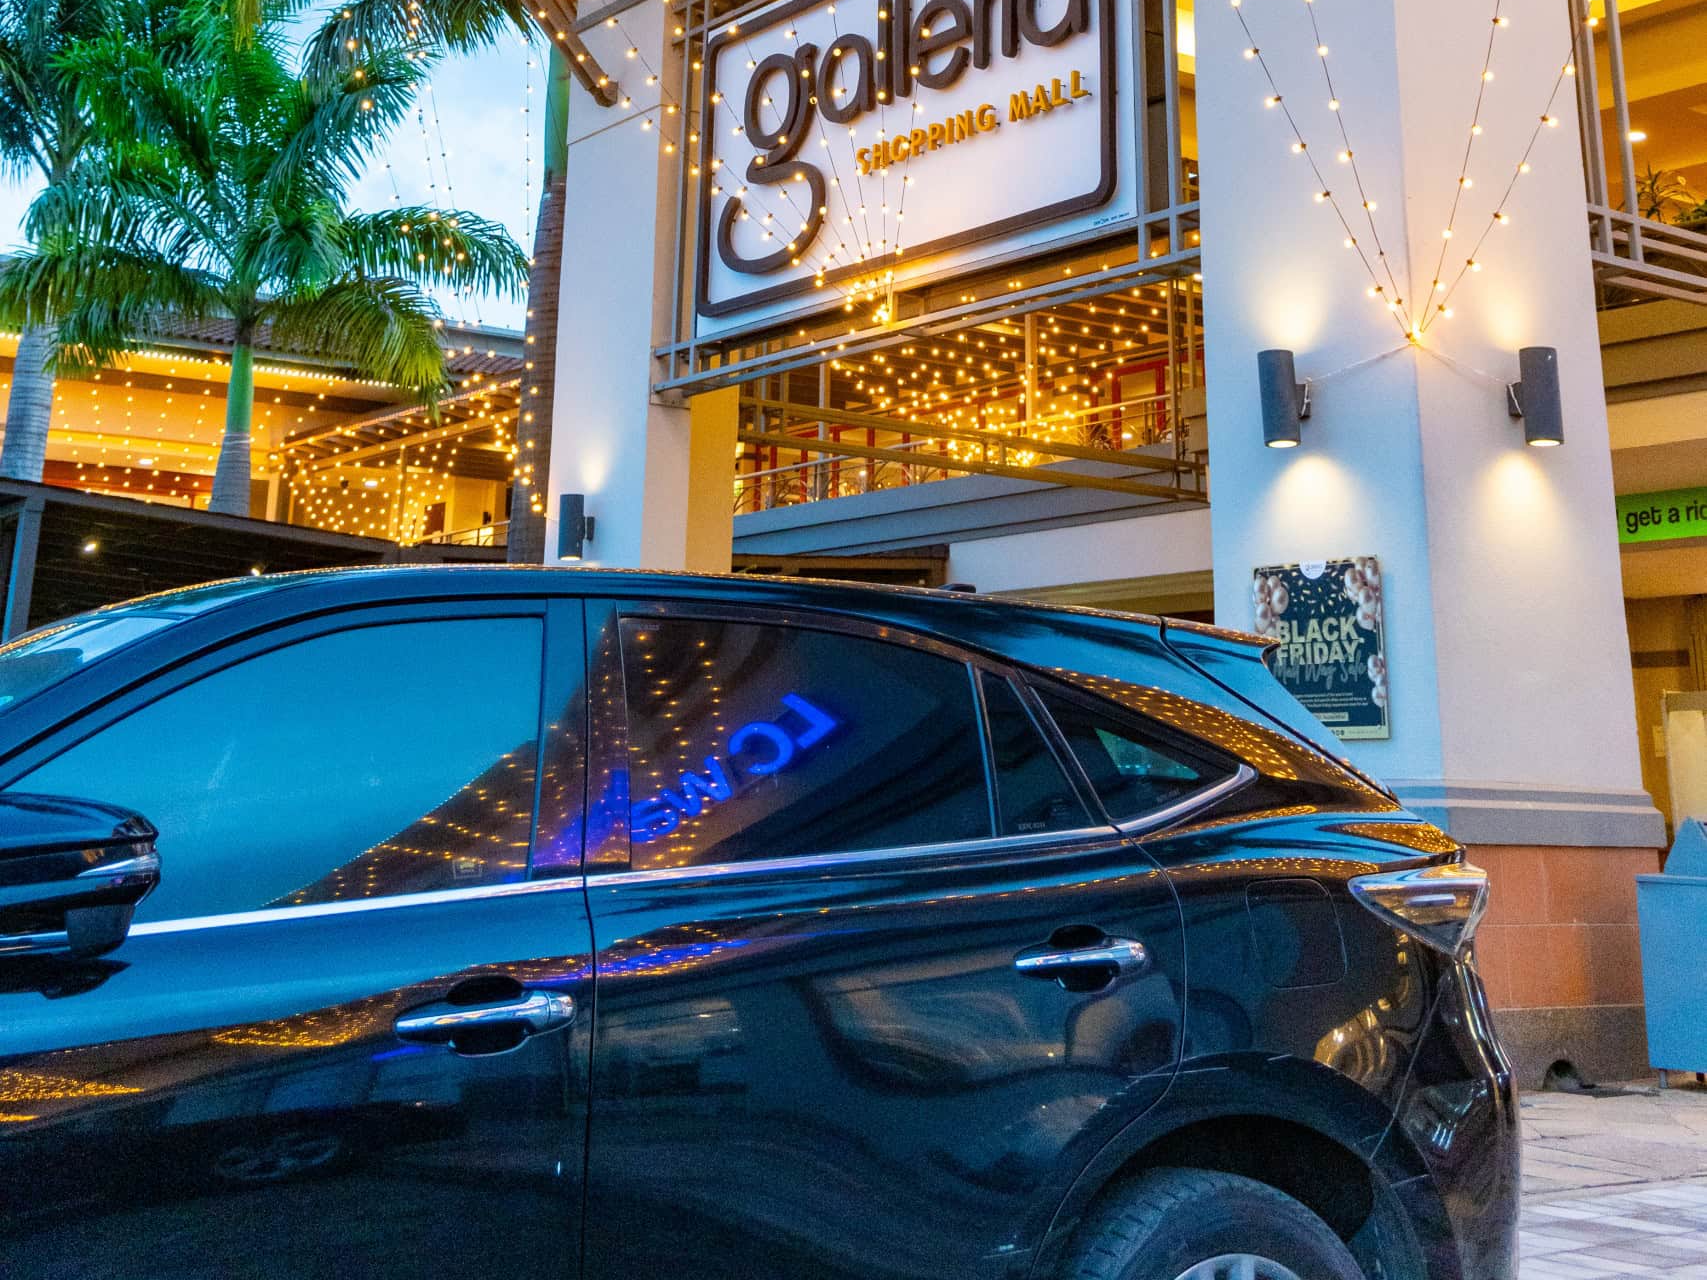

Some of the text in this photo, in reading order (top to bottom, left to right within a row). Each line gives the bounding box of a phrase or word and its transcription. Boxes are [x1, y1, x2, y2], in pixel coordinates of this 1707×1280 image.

[855, 70, 1089, 175] SHOPPING MALL
[1625, 506, 1662, 534] get
[1668, 506, 1680, 523] a
[1277, 616, 1359, 643] BLACK
[1276, 640, 1359, 666] FRIDAY
